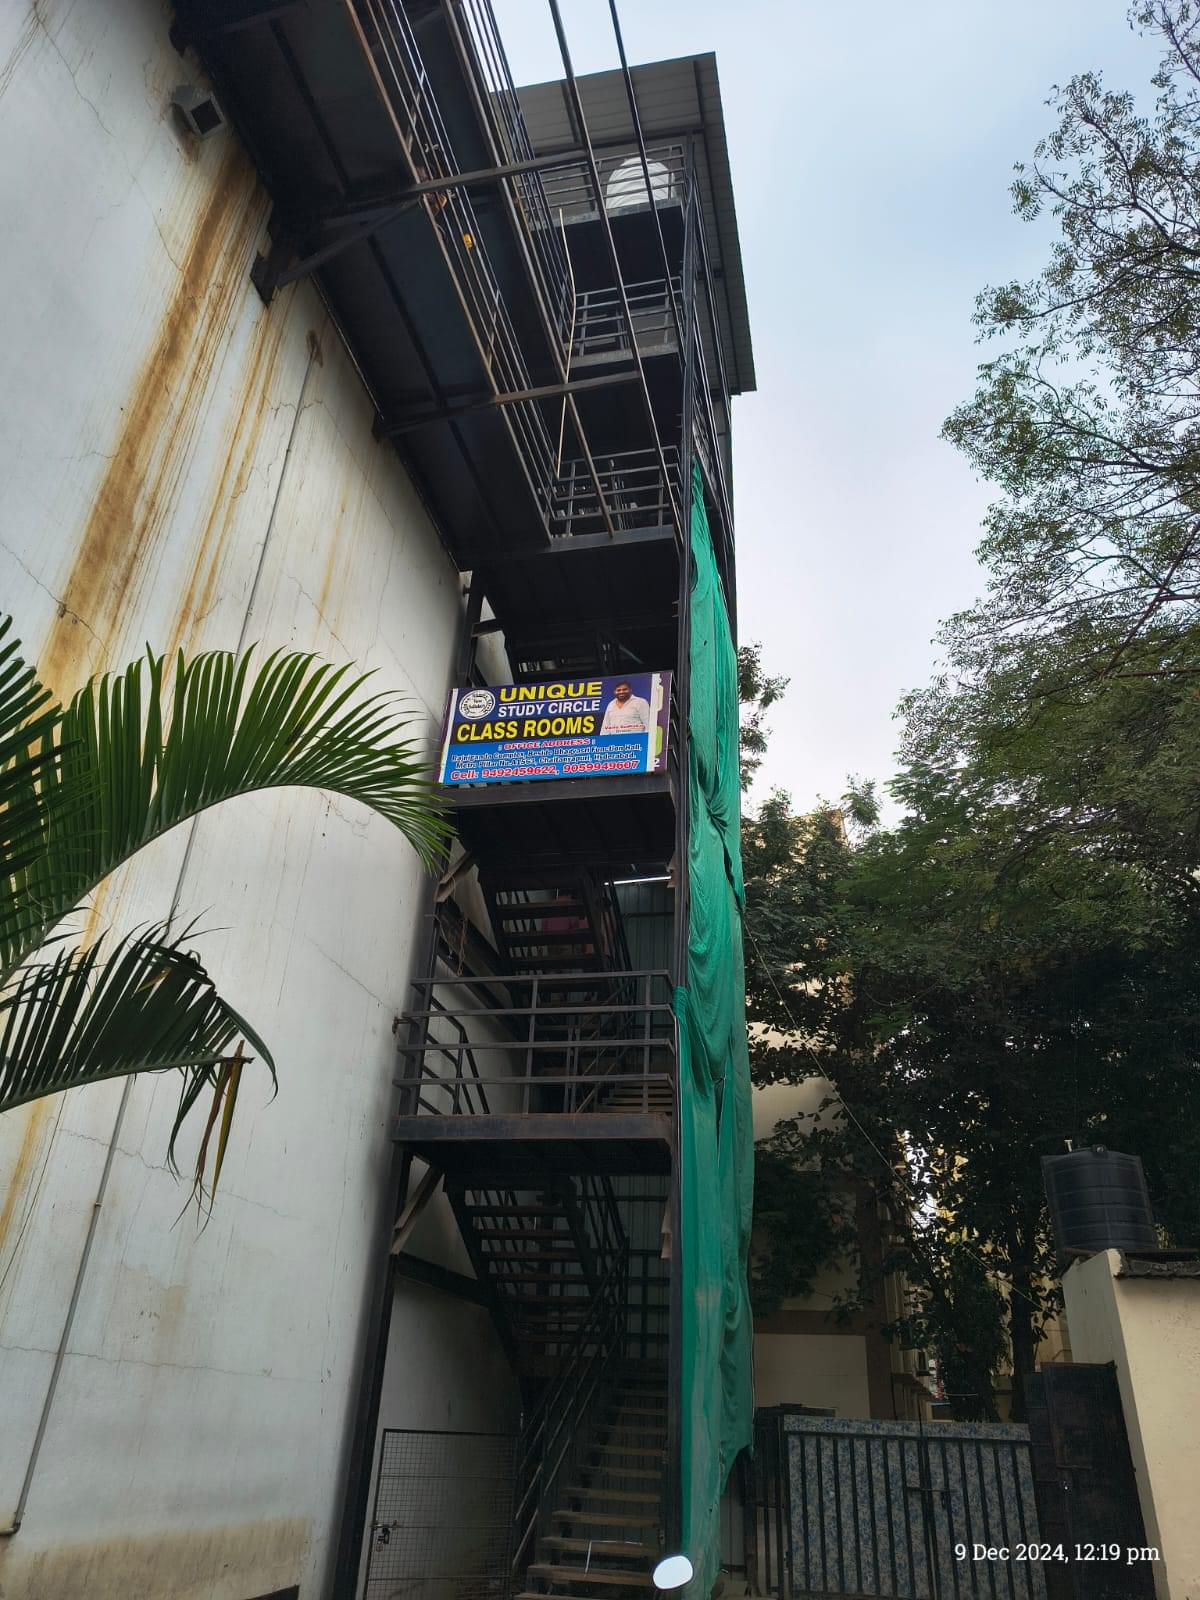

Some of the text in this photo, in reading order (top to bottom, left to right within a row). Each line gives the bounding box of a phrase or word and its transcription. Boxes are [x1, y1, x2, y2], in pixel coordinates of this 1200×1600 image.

[500, 681, 602, 702] UNIQUE
[498, 700, 600, 718] STUDY CIRCLE
[457, 716, 595, 741] CLASS ROOMS
[503, 741, 540, 751] OFFICE
[541, 738, 590, 748] ADDRESS
[451, 769, 479, 780] Cell:
